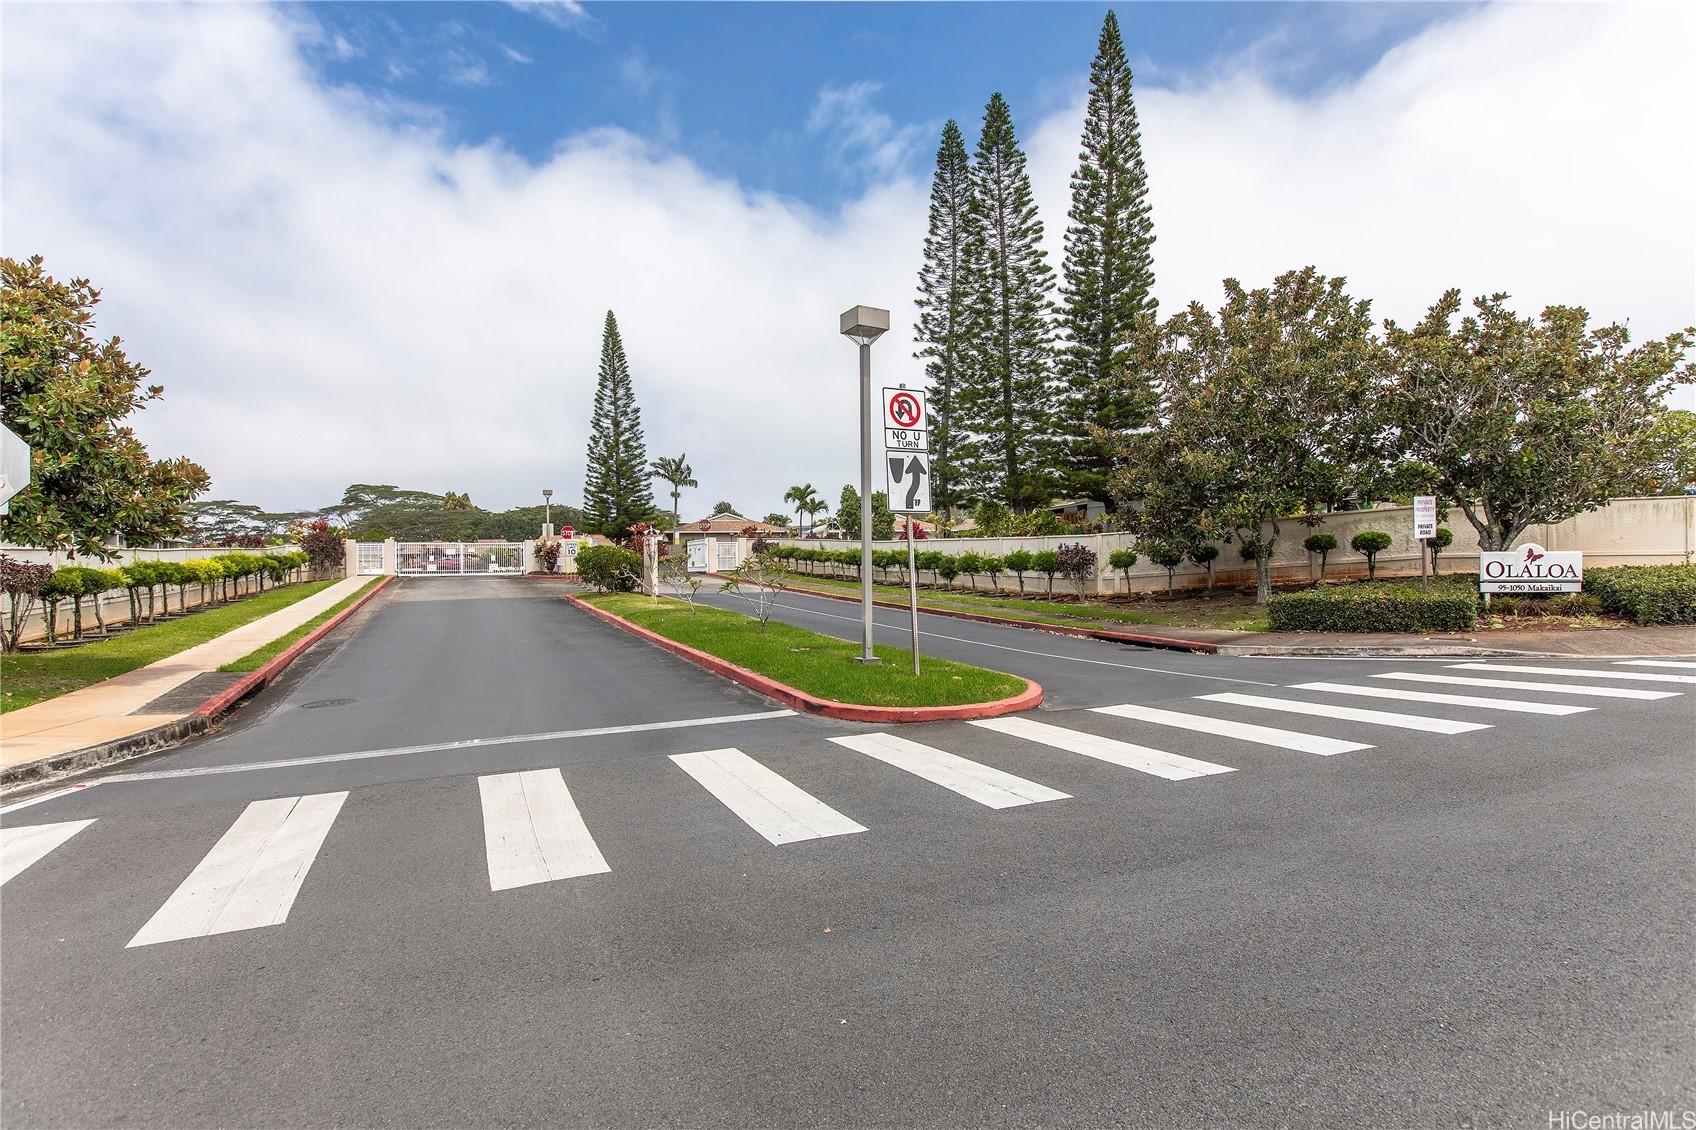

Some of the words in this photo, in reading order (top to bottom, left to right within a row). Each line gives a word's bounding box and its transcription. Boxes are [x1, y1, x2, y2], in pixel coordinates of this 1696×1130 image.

[892, 430, 907, 441] NO
[913, 431, 921, 441] U
[897, 439, 919, 448] TURN
[1485, 561, 1579, 578] OLALOA
[1498, 584, 1525, 592] 95-1050
